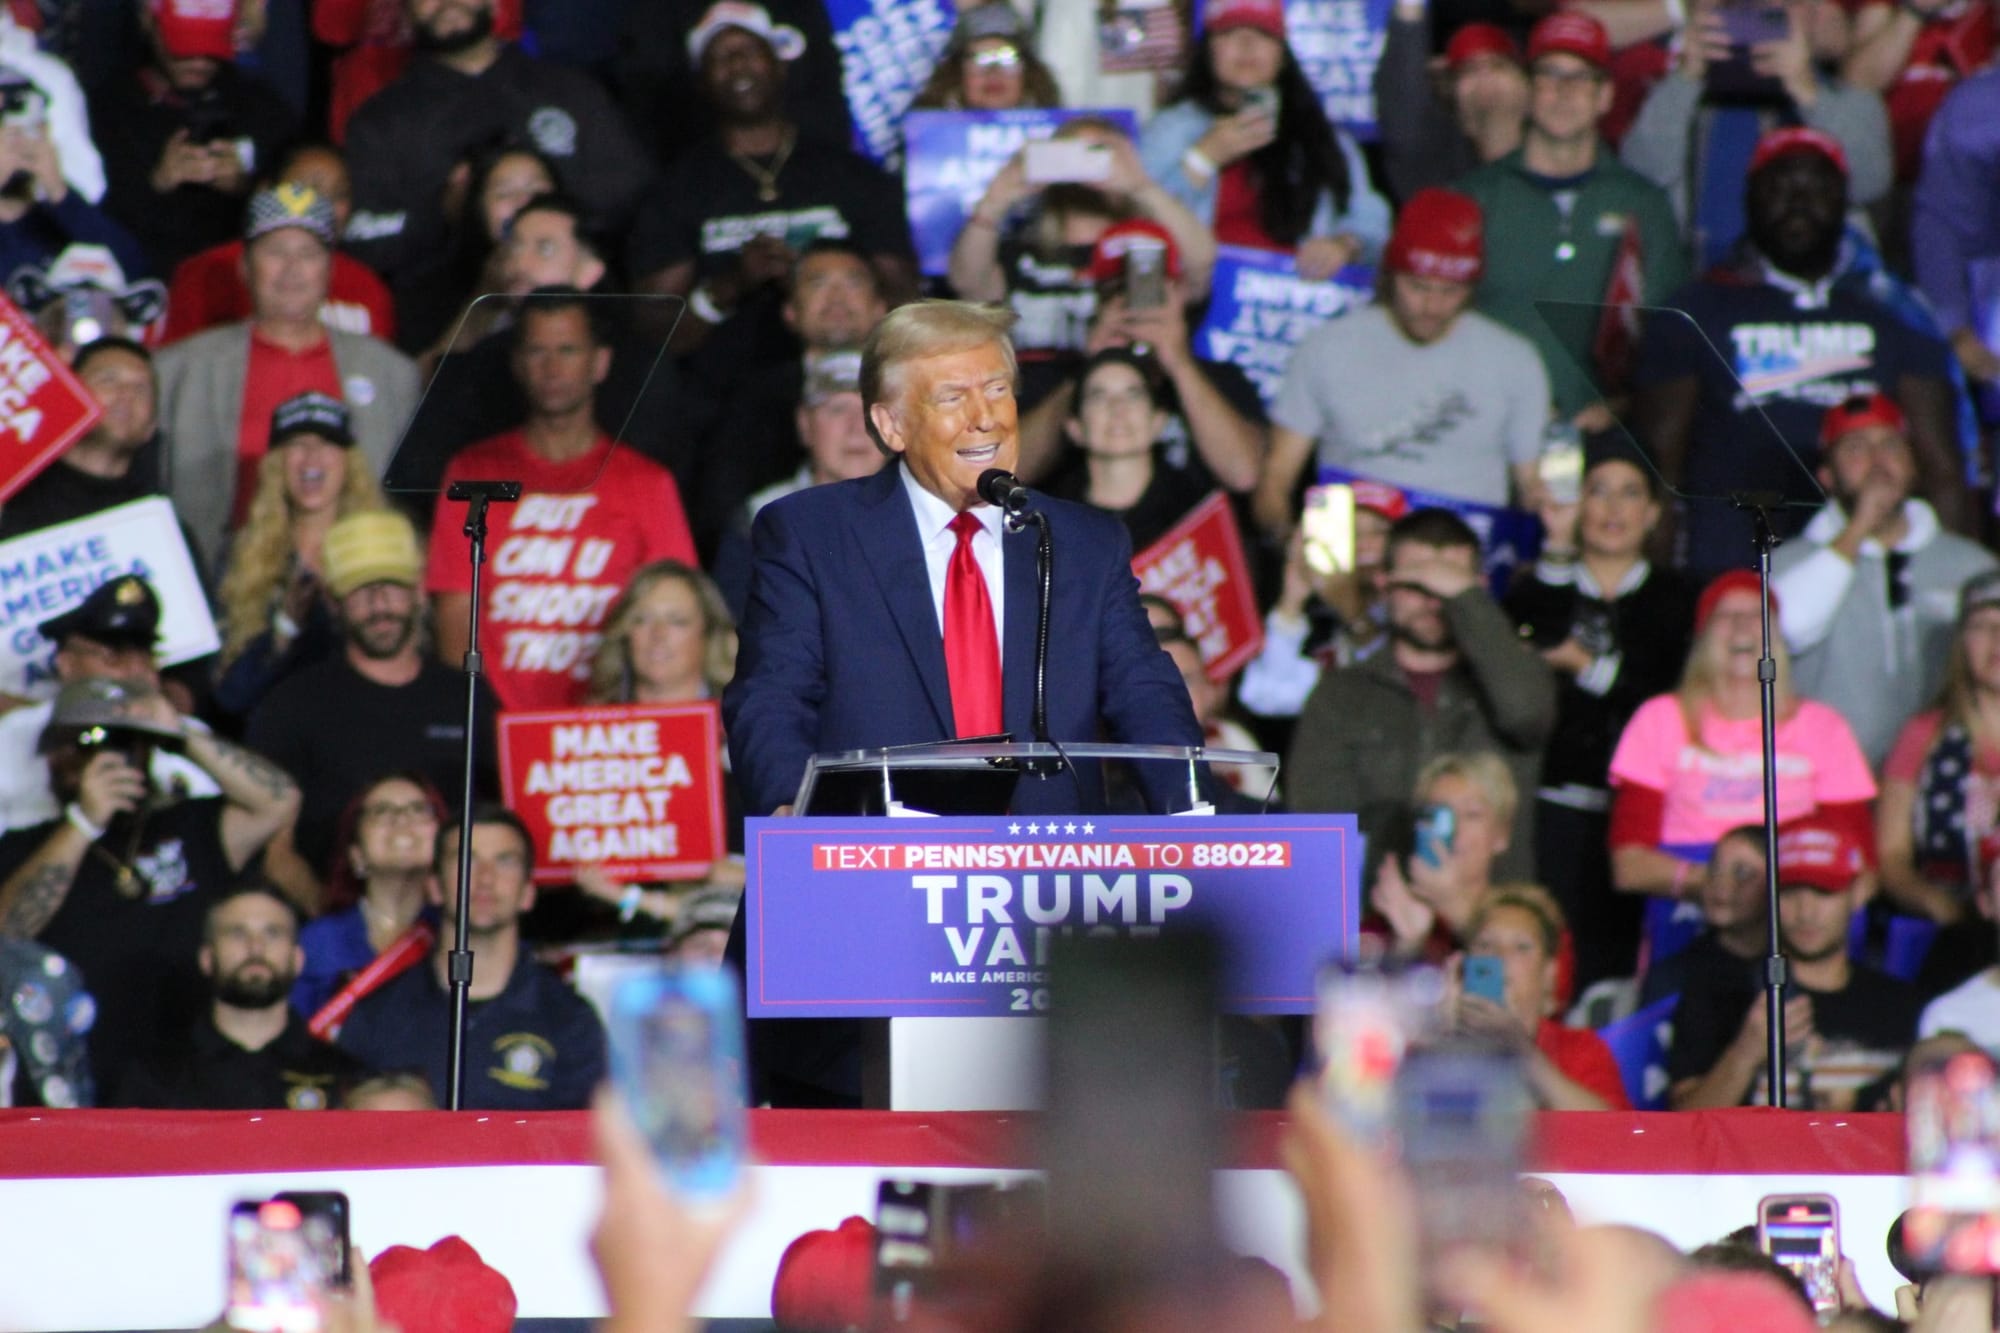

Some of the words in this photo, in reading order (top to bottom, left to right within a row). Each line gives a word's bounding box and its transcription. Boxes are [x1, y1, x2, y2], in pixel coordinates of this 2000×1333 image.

[1731, 323, 1876, 362] TRUMP
[0, 535, 110, 592] MAKE
[493, 534, 575, 578] CAN
[574, 537, 615, 580] U
[490, 581, 621, 626] SHOOT
[552, 719, 660, 758] MAKE
[525, 754, 693, 796] AMERICA
[546, 790, 671, 827] GREAT
[549, 823, 678, 862] AGAIN!
[820, 846, 896, 868] TEXT
[904, 844, 1135, 868] PENNSYLVANIA
[1143, 844, 1183, 867] TO
[1192, 843, 1284, 866] 88022
[912, 874, 1193, 924] TRUMP
[930, 971, 976, 983] MAKE
[981, 971, 1049, 983] AMERIC
